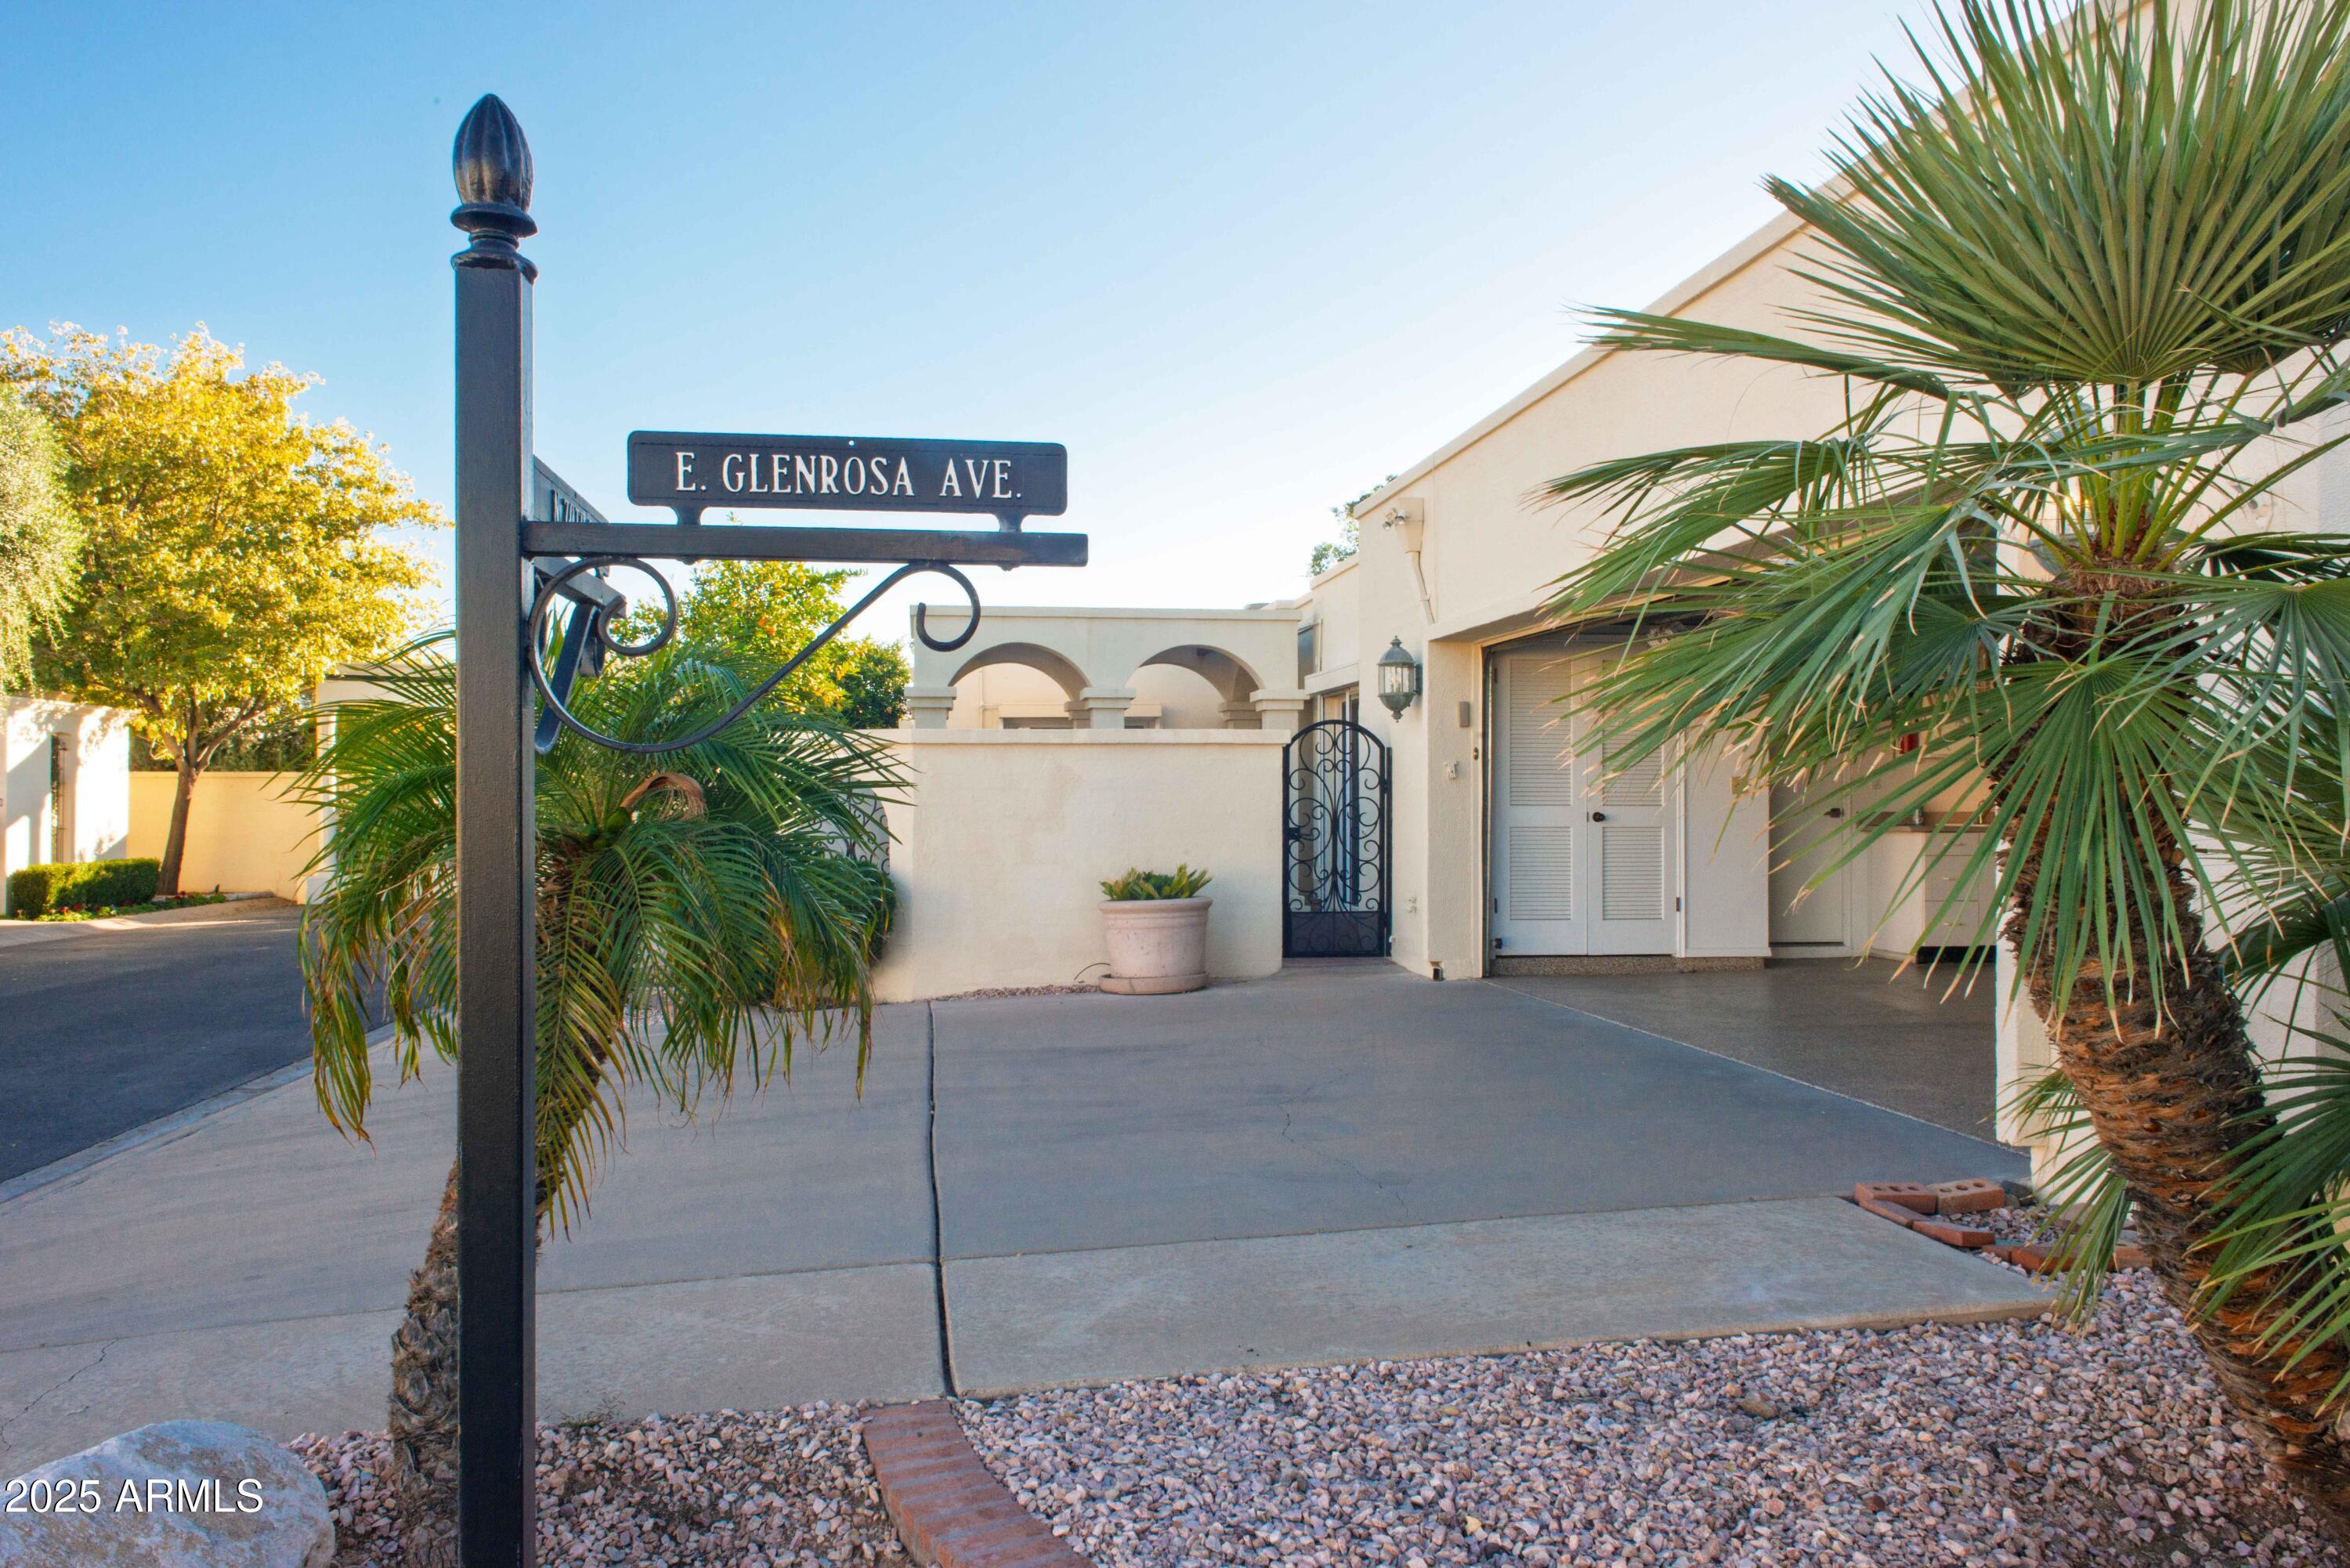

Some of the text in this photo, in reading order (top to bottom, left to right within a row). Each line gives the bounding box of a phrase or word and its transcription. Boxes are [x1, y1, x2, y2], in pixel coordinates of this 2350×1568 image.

[675, 451, 1021, 499] E. GLENROSA AVE.
